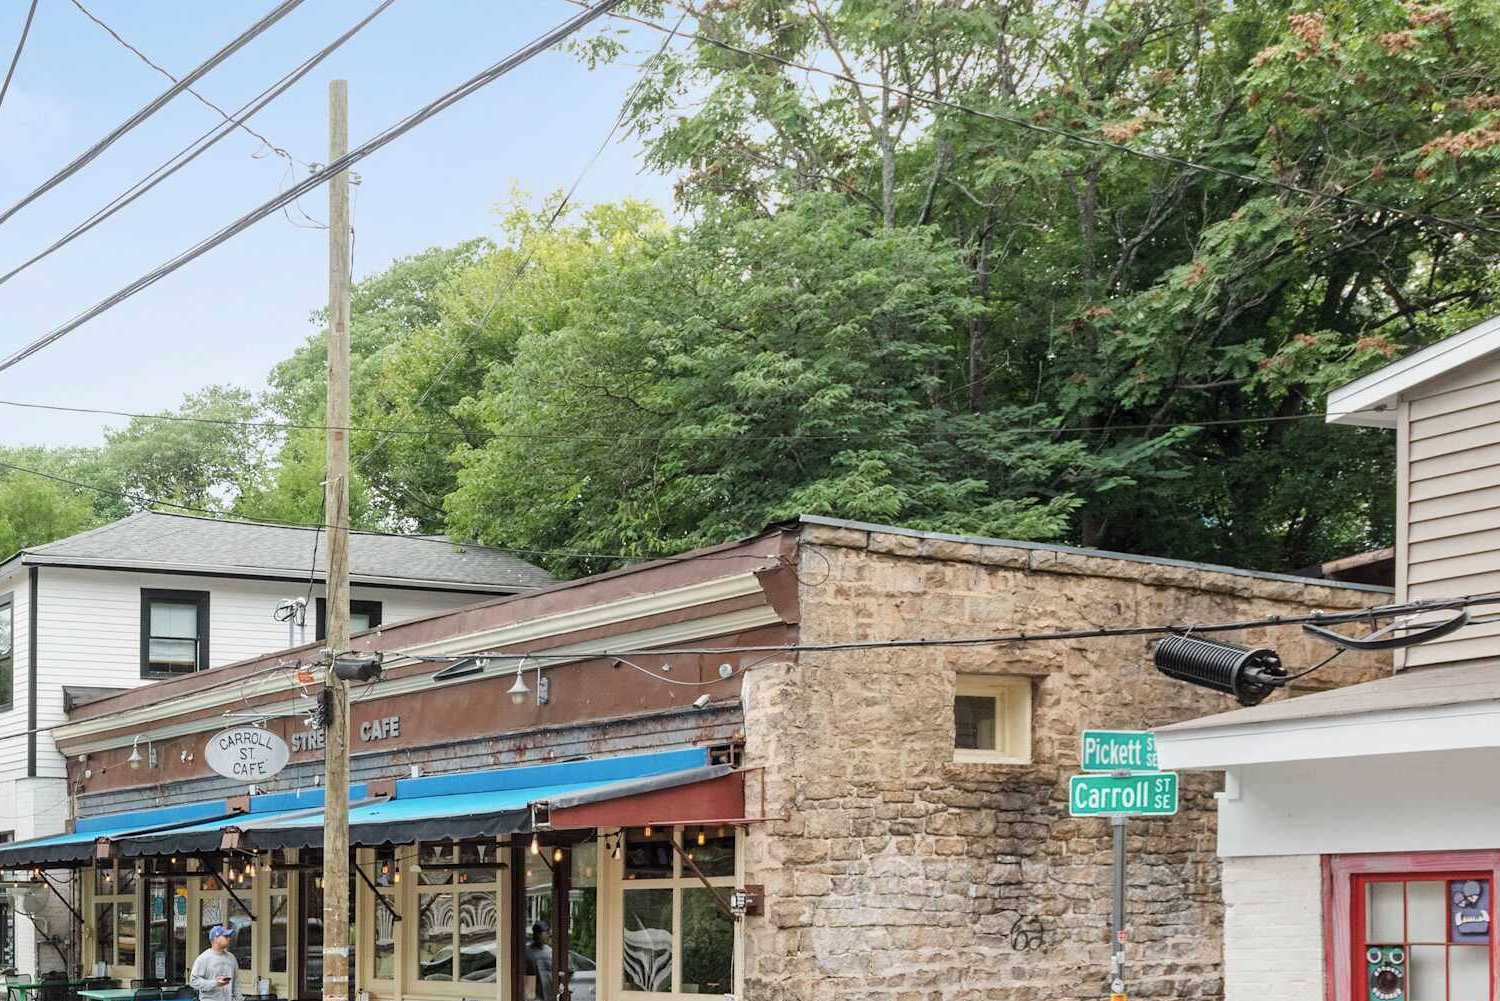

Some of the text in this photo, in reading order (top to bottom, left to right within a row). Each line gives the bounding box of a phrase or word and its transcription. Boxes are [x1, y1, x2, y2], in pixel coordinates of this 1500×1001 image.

[219, 732, 273, 751] CARROLL
[292, 716, 400, 752] STRE CAFE
[1084, 738, 1142, 765] Pickett
[1075, 781, 1149, 809] Carroll
[1156, 778, 1171, 793] ST
[1154, 794, 1171, 809] SE
